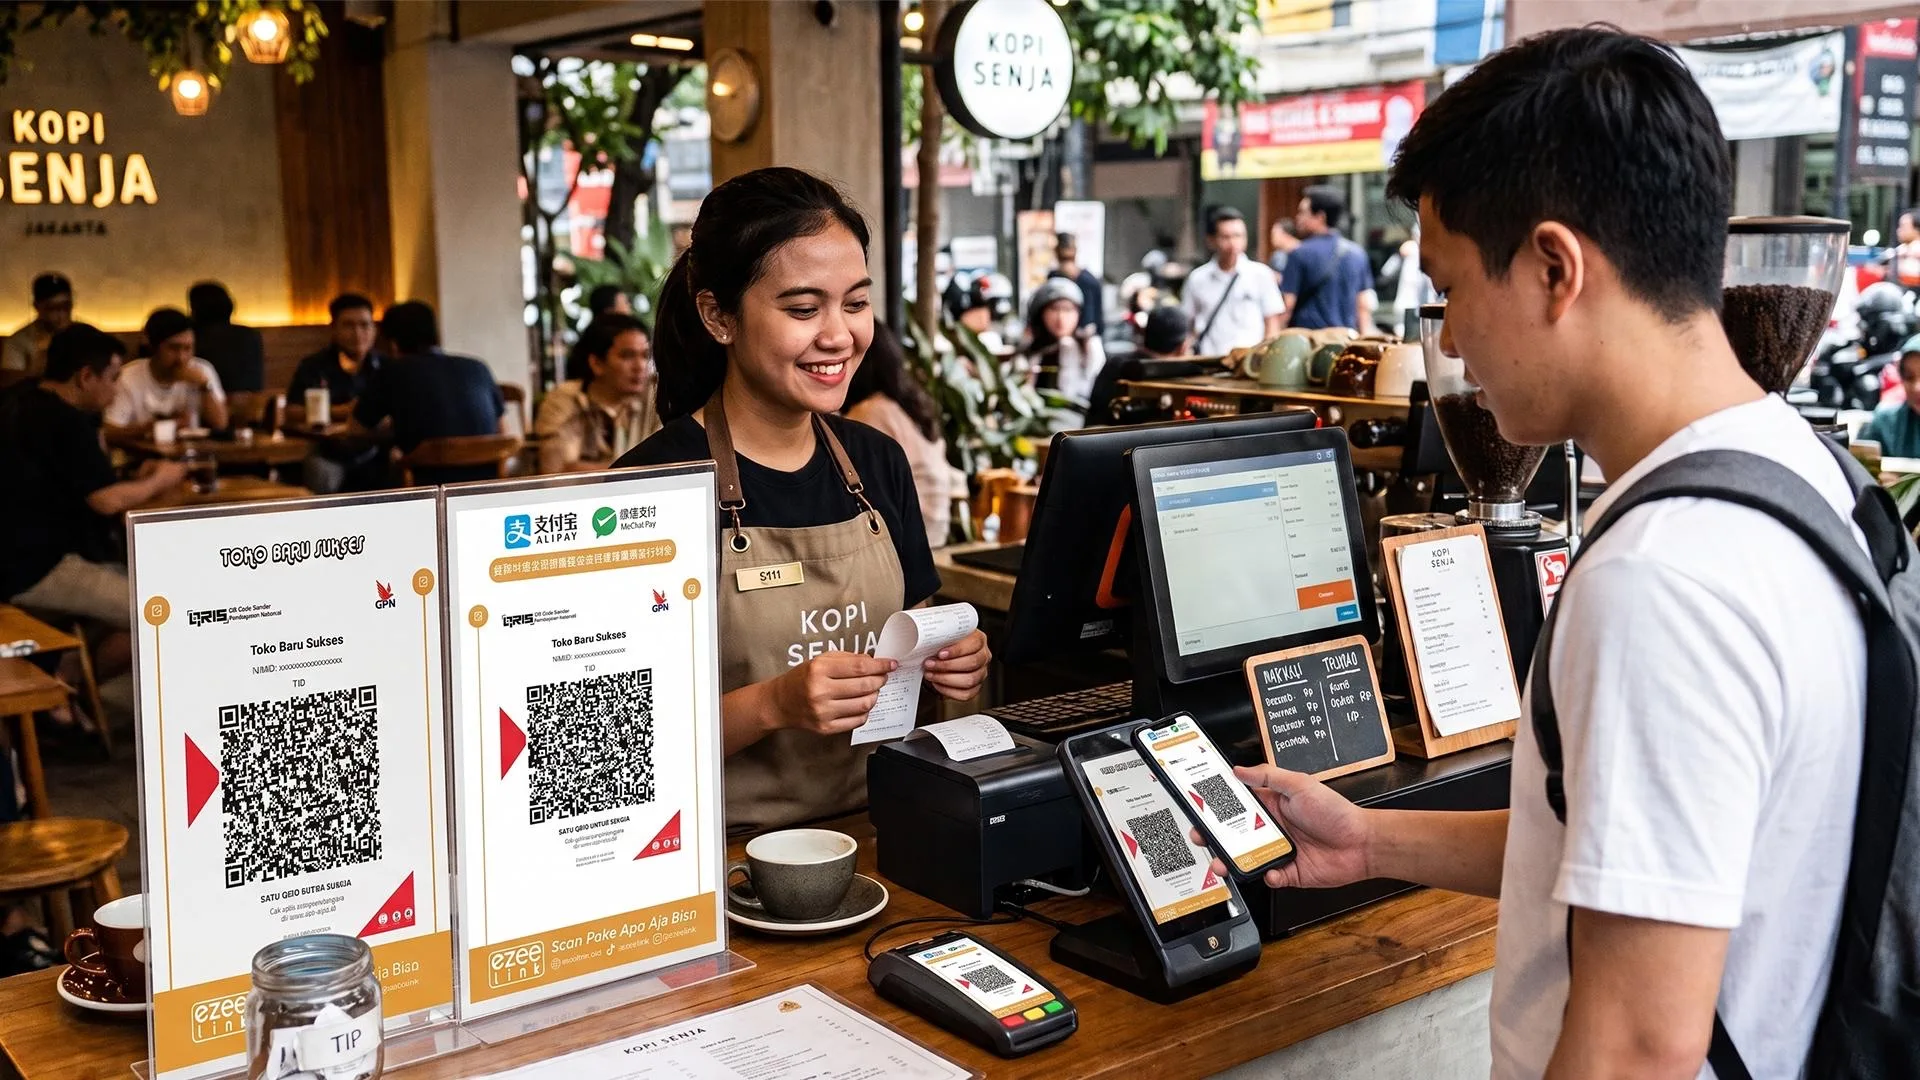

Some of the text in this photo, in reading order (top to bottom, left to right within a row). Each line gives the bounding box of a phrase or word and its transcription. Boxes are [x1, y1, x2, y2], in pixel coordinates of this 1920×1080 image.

[988, 32, 1043, 56] KOPI
[974, 61, 1053, 92] SENJA
[13, 109, 105, 145] KOPI
[0, 151, 159, 208] ENJA
[534, 512, 578, 534] 支付宝
[645, 520, 657, 529] Pay
[535, 532, 578, 545] ALIPAY
[220, 535, 366, 569] TOKO BARU SUKSES
[1432, 548, 1450, 557] KOPI
[1431, 557, 1455, 568] SENJA
[375, 599, 396, 609] GPN
[652, 603, 669, 612] GPN
[801, 601, 867, 635] KOPI
[250, 636, 344, 655] Toko Baru Sukses
[551, 631, 627, 648] Toko Baru Sukses
[584, 664, 596, 672] TID
[293, 679, 306, 687] TID
[558, 827, 574, 835] SATU
[260, 893, 280, 903] SATU
[551, 937, 582, 953] Scan
[648, 915, 669, 931] Aja
[491, 944, 542, 970] ezee
[494, 962, 540, 985] link
[195, 996, 247, 1023] ezee
[330, 1028, 362, 1053] TIP
[623, 1041, 657, 1055] KOPI
